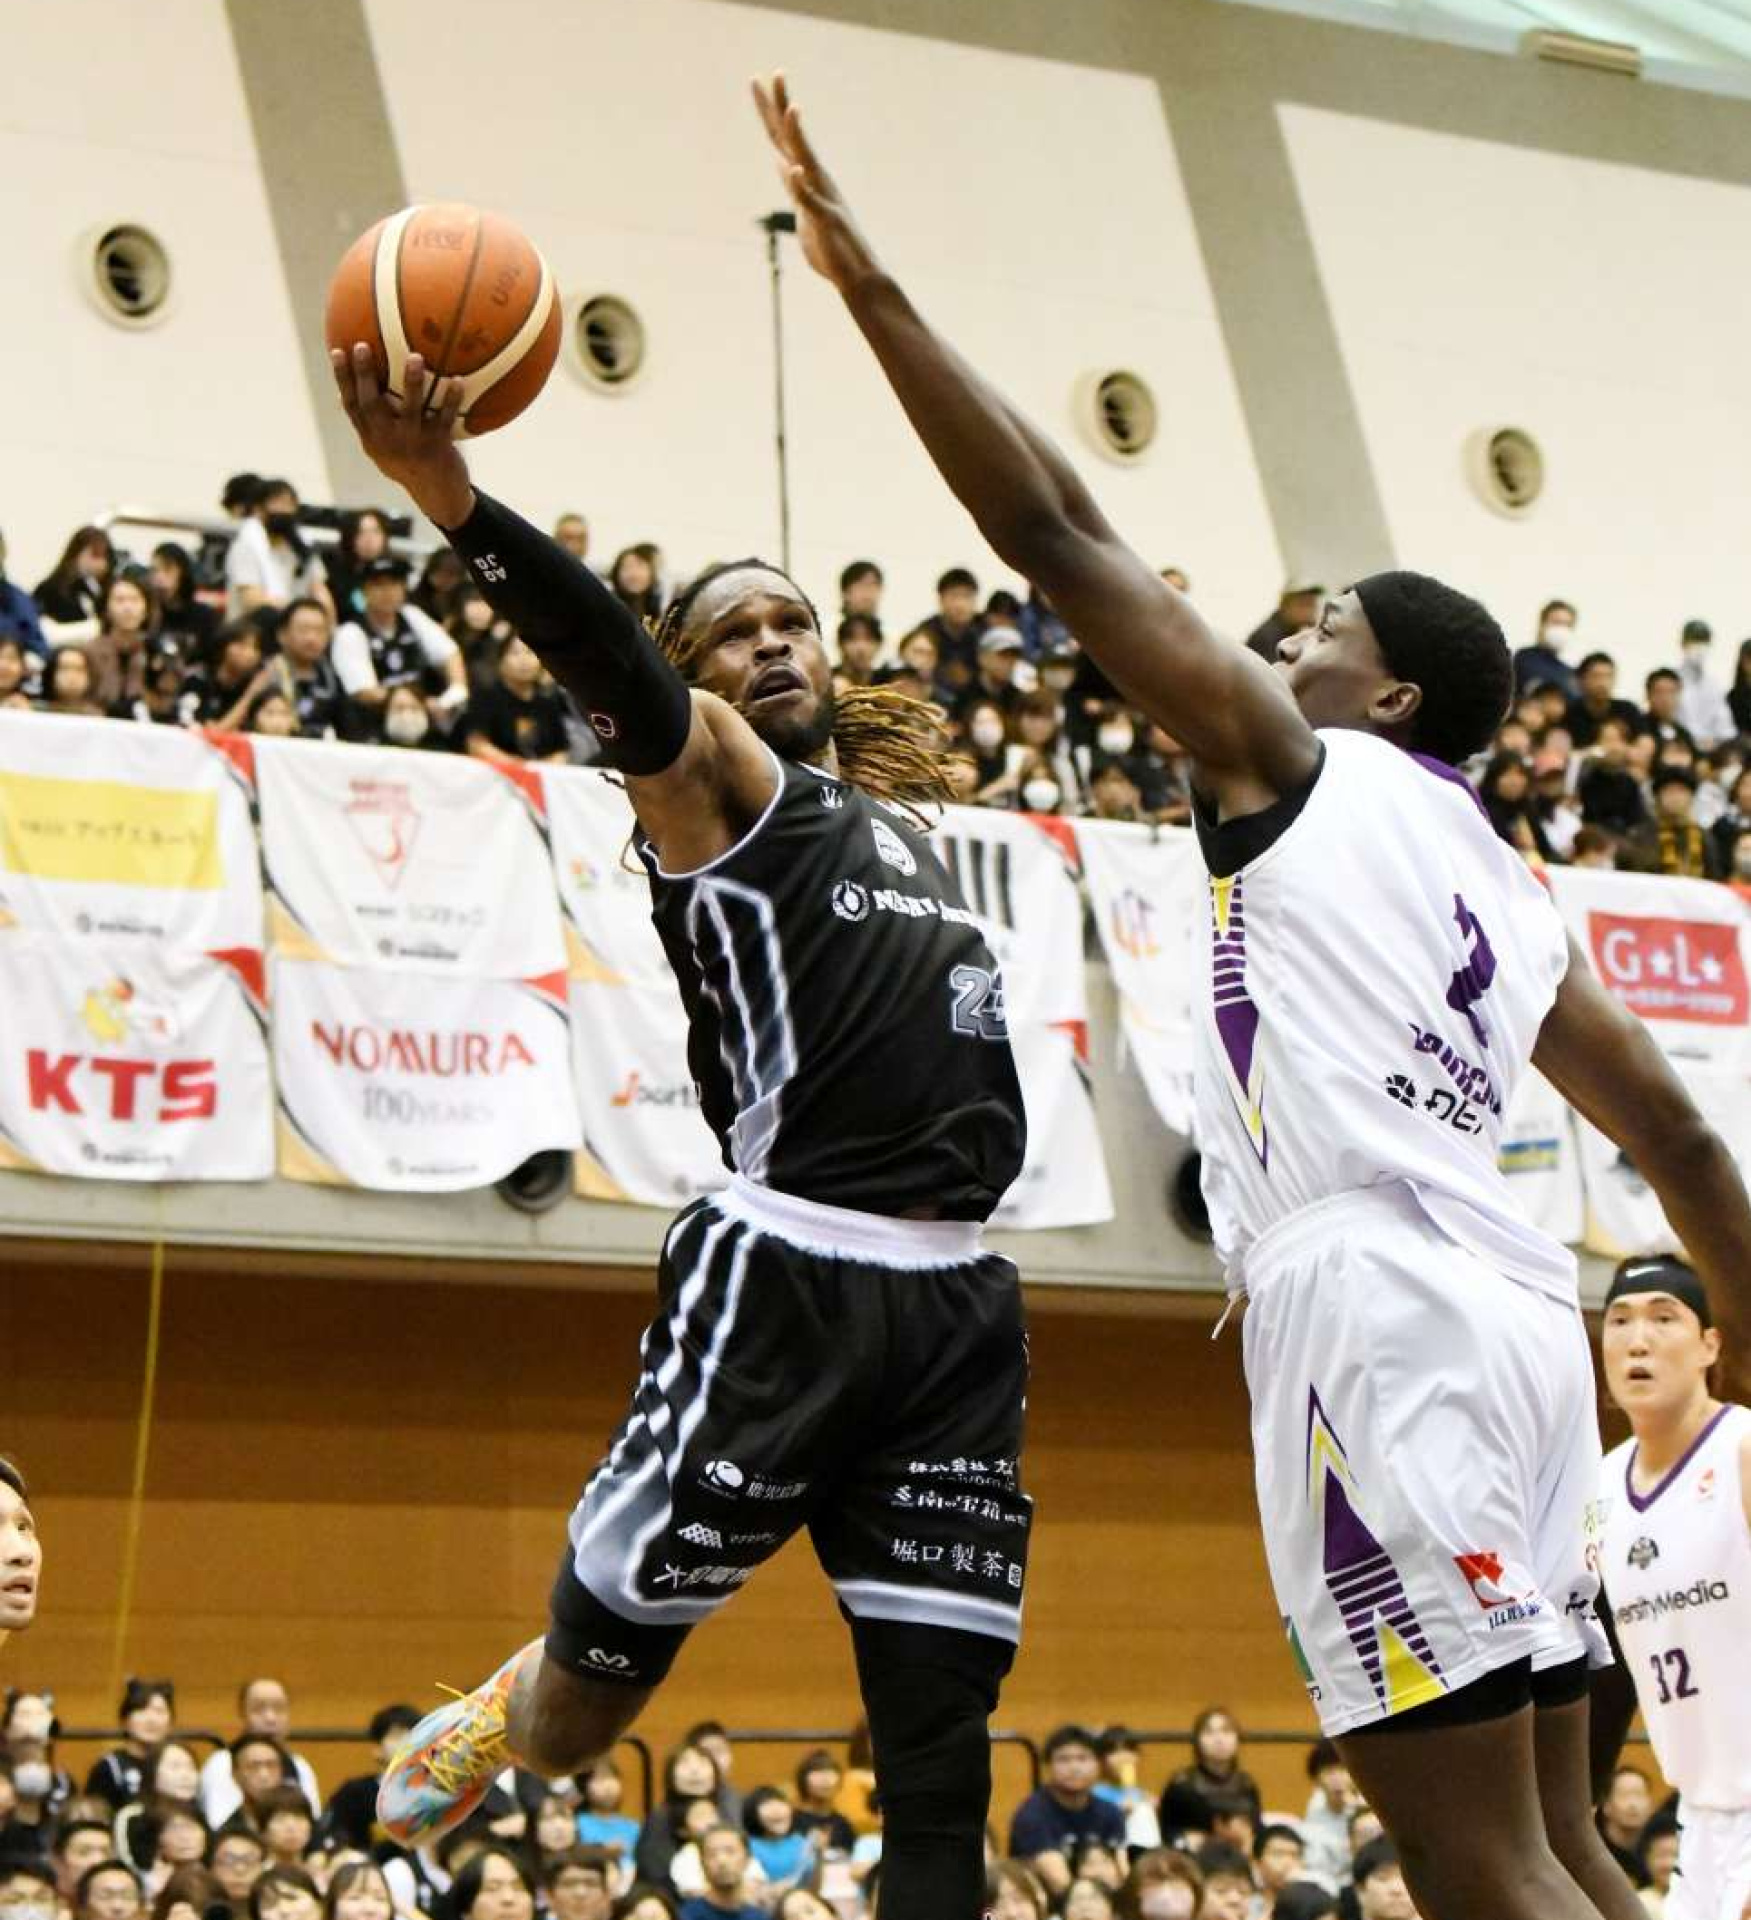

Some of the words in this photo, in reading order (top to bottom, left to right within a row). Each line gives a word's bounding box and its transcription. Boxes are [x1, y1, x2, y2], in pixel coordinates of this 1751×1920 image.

[311, 1020, 535, 1077] NOMURA
[26, 1048, 219, 1122] KTS
[891, 1538, 1004, 1578] 堀口製茶
